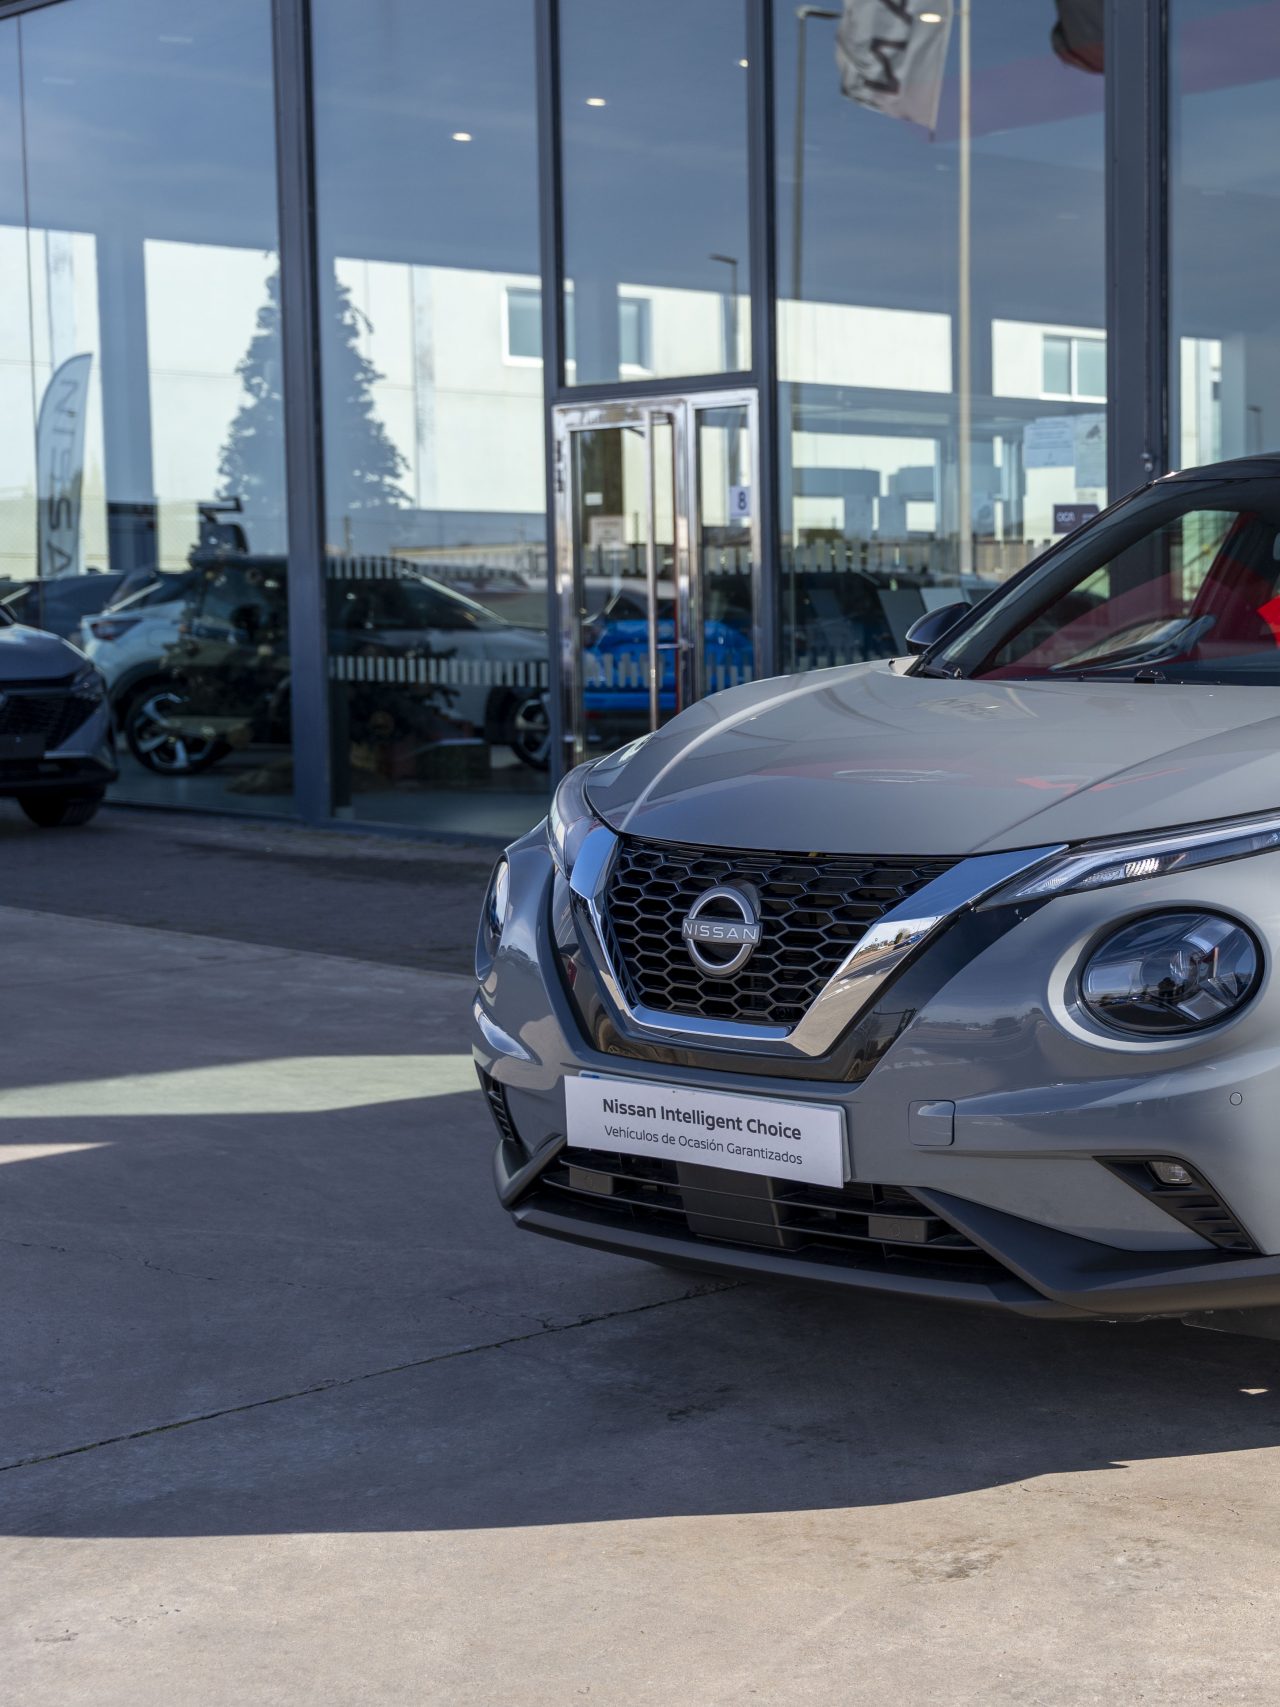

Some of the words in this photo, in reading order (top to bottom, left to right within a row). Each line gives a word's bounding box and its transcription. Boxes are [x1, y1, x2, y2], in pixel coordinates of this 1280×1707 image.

[46, 379, 79, 576] NISSA
[682, 922, 757, 940] NISSAN
[602, 1098, 657, 1119] Nissan
[660, 1105, 743, 1132] Intelligent
[746, 1118, 802, 1141] Choice
[604, 1124, 659, 1143] Vehículos
[661, 1132, 676, 1146] de
[678, 1135, 724, 1153] Ocasión
[726, 1142, 803, 1165] Garantizados
